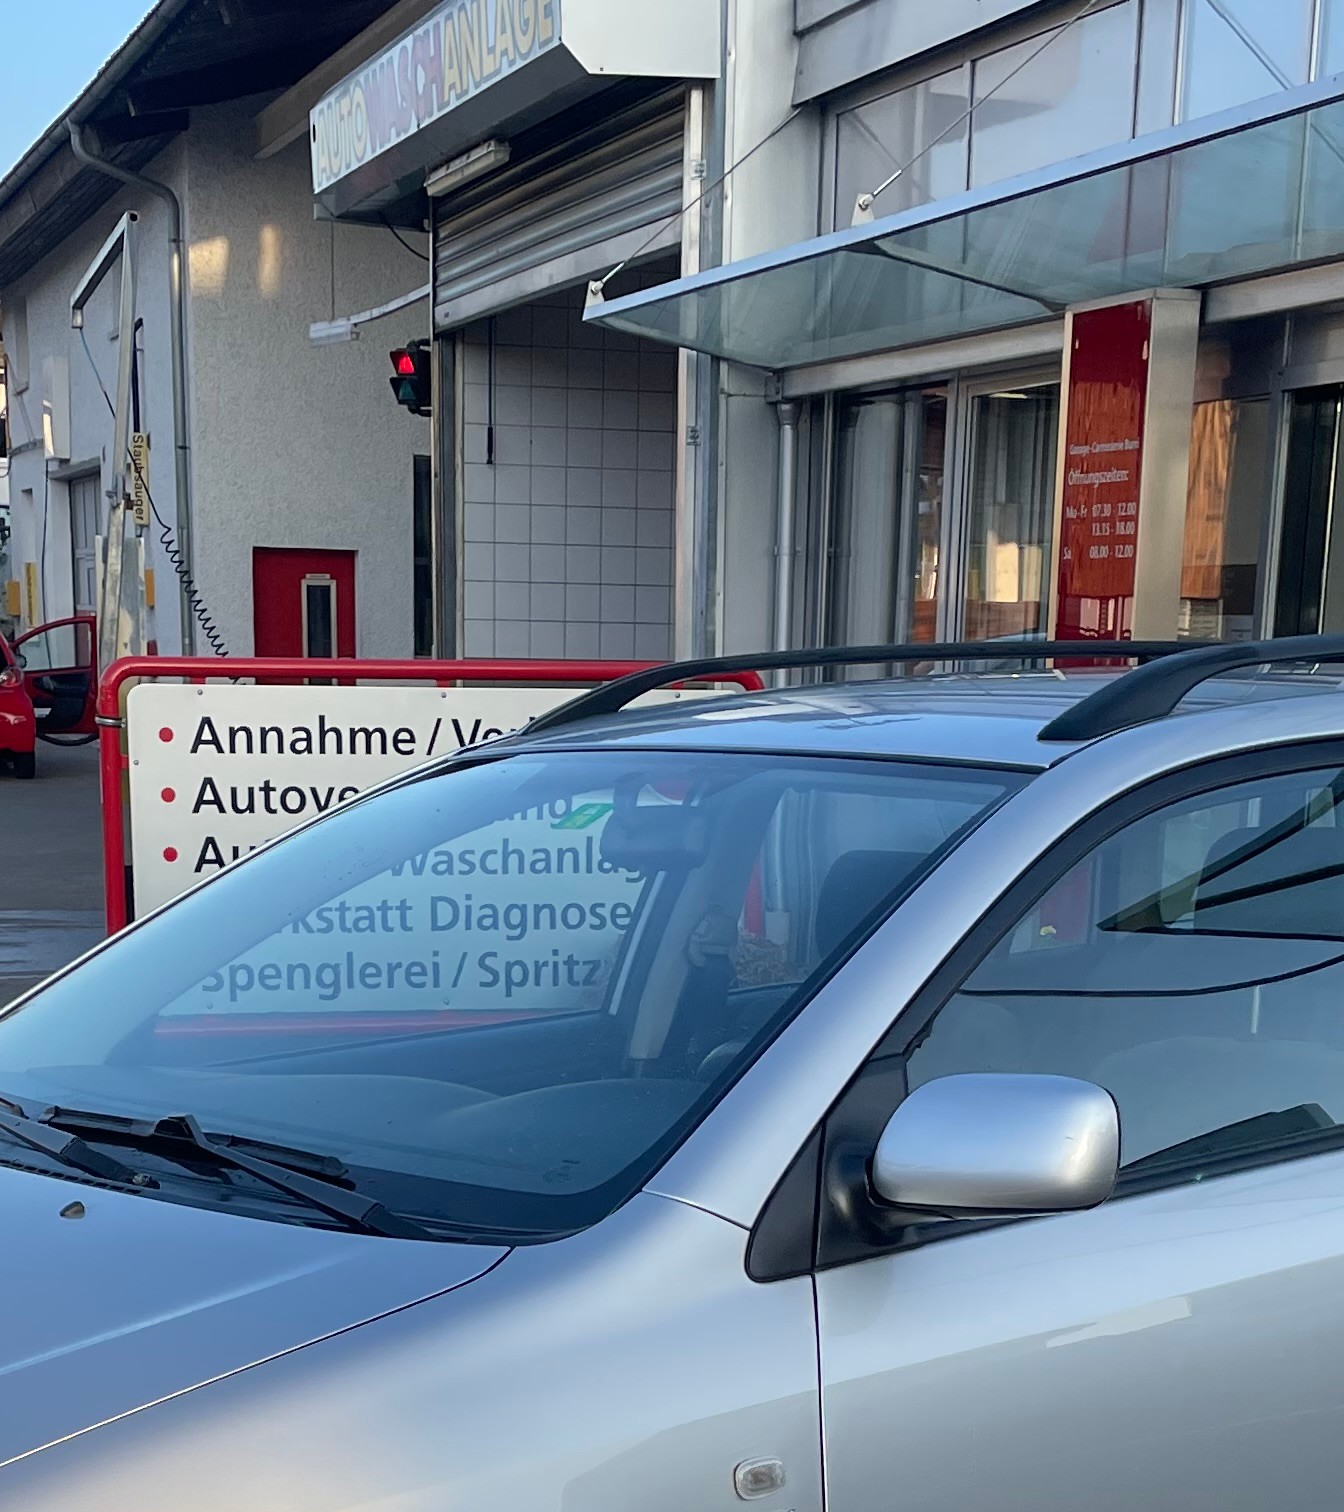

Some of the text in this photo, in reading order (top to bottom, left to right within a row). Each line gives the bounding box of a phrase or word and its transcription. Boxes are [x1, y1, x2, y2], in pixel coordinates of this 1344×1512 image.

[316, 0, 556, 188] AUTOWASCHANLAGE
[132, 434, 145, 521] Staubsauger
[190, 715, 417, 756] Annahme
[430, 893, 633, 941] Diagnose
[202, 950, 442, 1002] Spenglerei
[478, 949, 609, 998] Spritz
